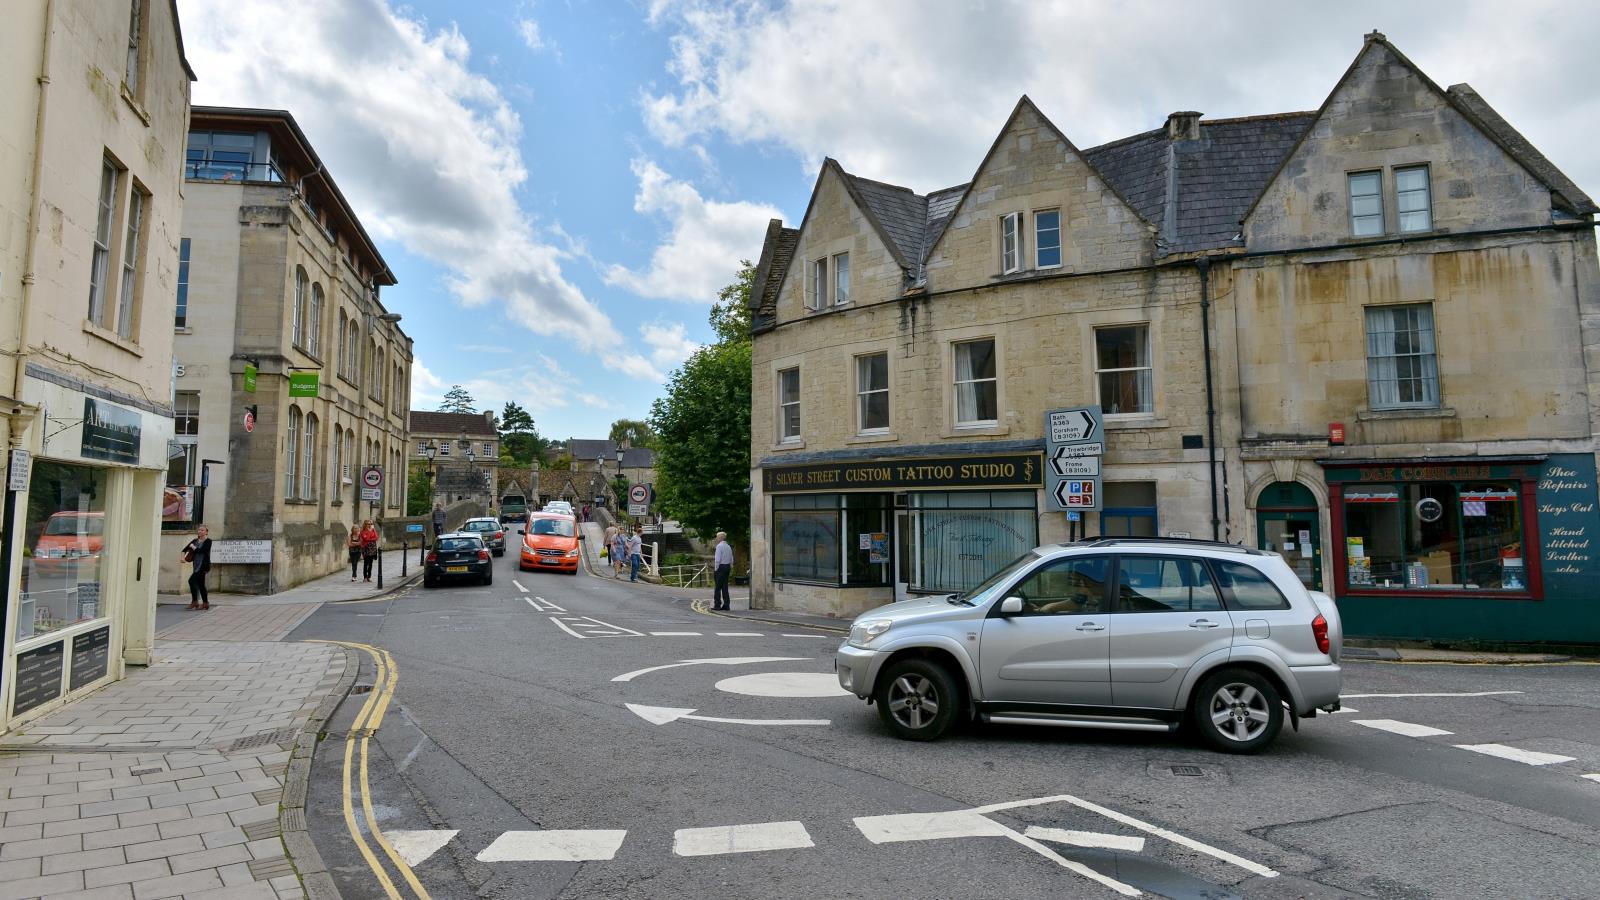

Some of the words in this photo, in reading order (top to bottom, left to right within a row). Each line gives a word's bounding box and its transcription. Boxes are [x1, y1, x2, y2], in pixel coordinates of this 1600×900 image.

[1068, 445, 1100, 453] Trowbridge
[776, 472, 803, 485] SILVER
[807, 469, 840, 484] STREET
[845, 467, 891, 482] CUSTOM
[896, 465, 953, 480] TATTOO
[961, 463, 1015, 478] STUDIO
[1546, 466, 1578, 477] Shoe
[1538, 479, 1588, 493] Repairs
[1538, 503, 1569, 516] Keys
[1571, 502, 1593, 512] Cut
[1549, 526, 1585, 536] Hand
[1546, 539, 1589, 549] stitched
[1546, 551, 1590, 561] Leather
[1556, 564, 1581, 574] soles
